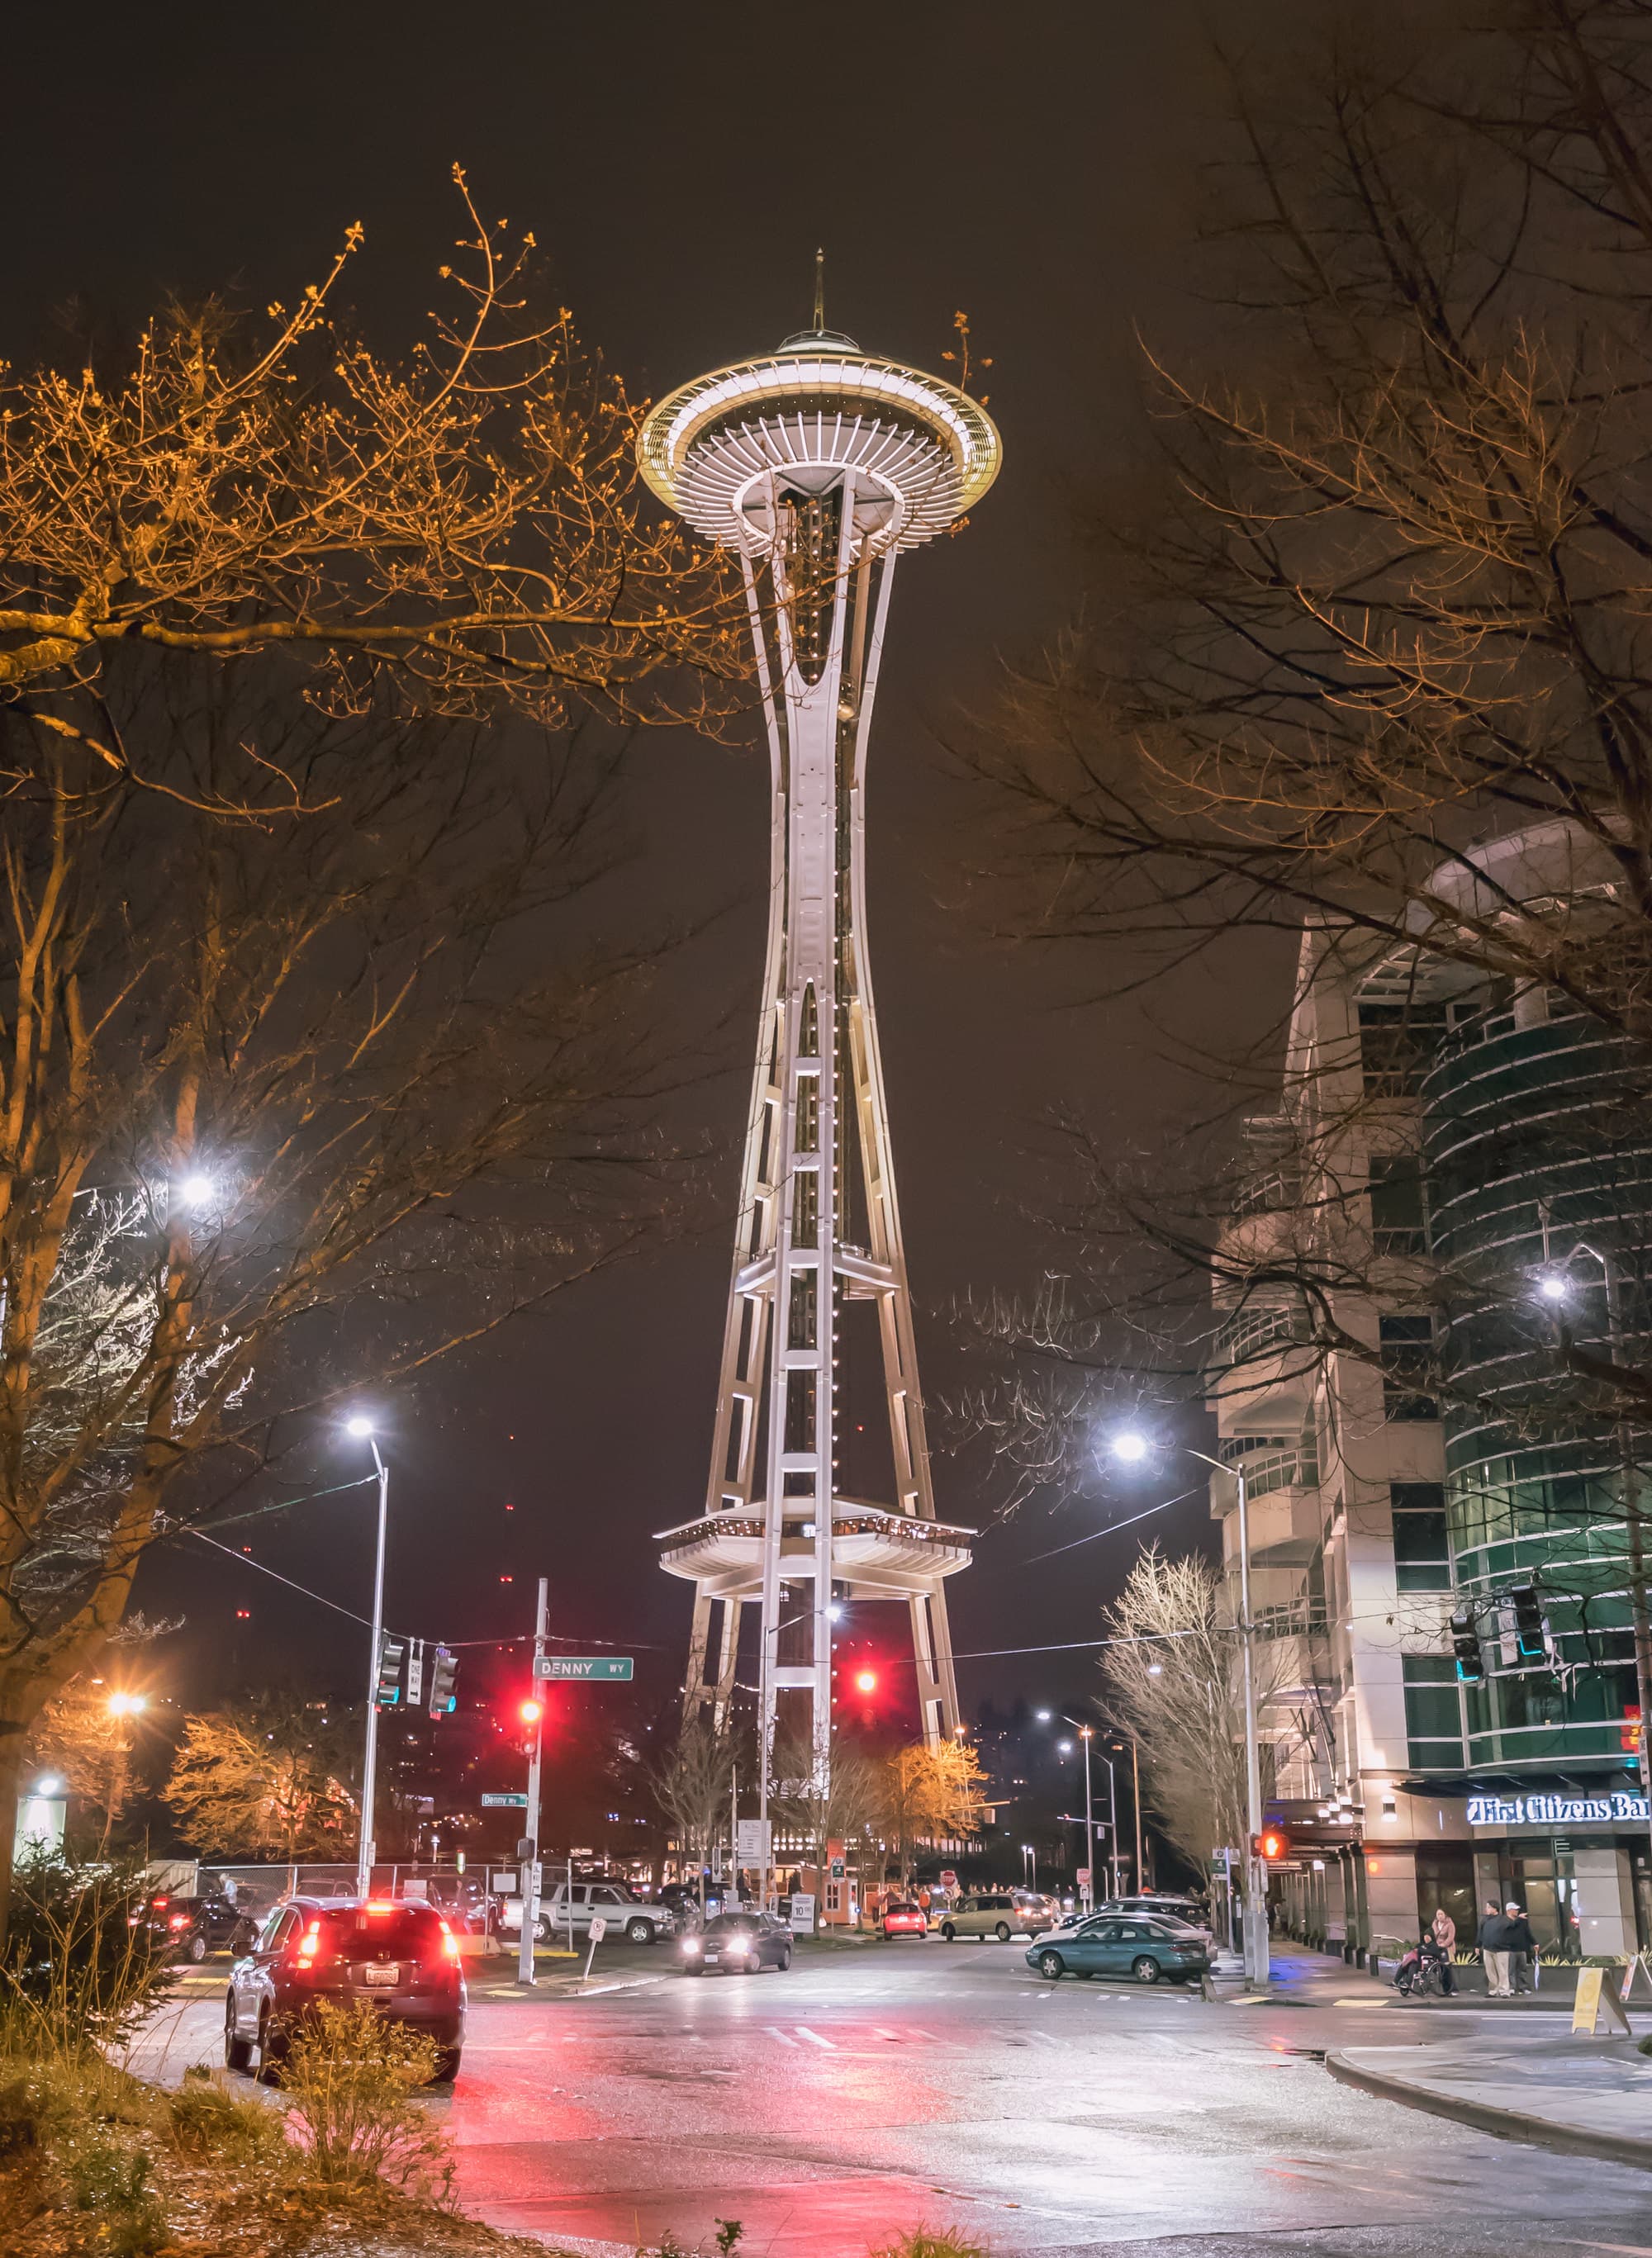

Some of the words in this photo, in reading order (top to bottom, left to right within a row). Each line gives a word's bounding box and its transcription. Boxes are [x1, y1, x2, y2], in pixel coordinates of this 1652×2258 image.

[541, 1662, 593, 1675] DENNY
[609, 1663, 624, 1673] WY
[484, 1795, 507, 1805] Denny
[1469, 1797, 1524, 1824] First
[1526, 1795, 1612, 1823] Citizens
[795, 1906, 804, 1916] 10
